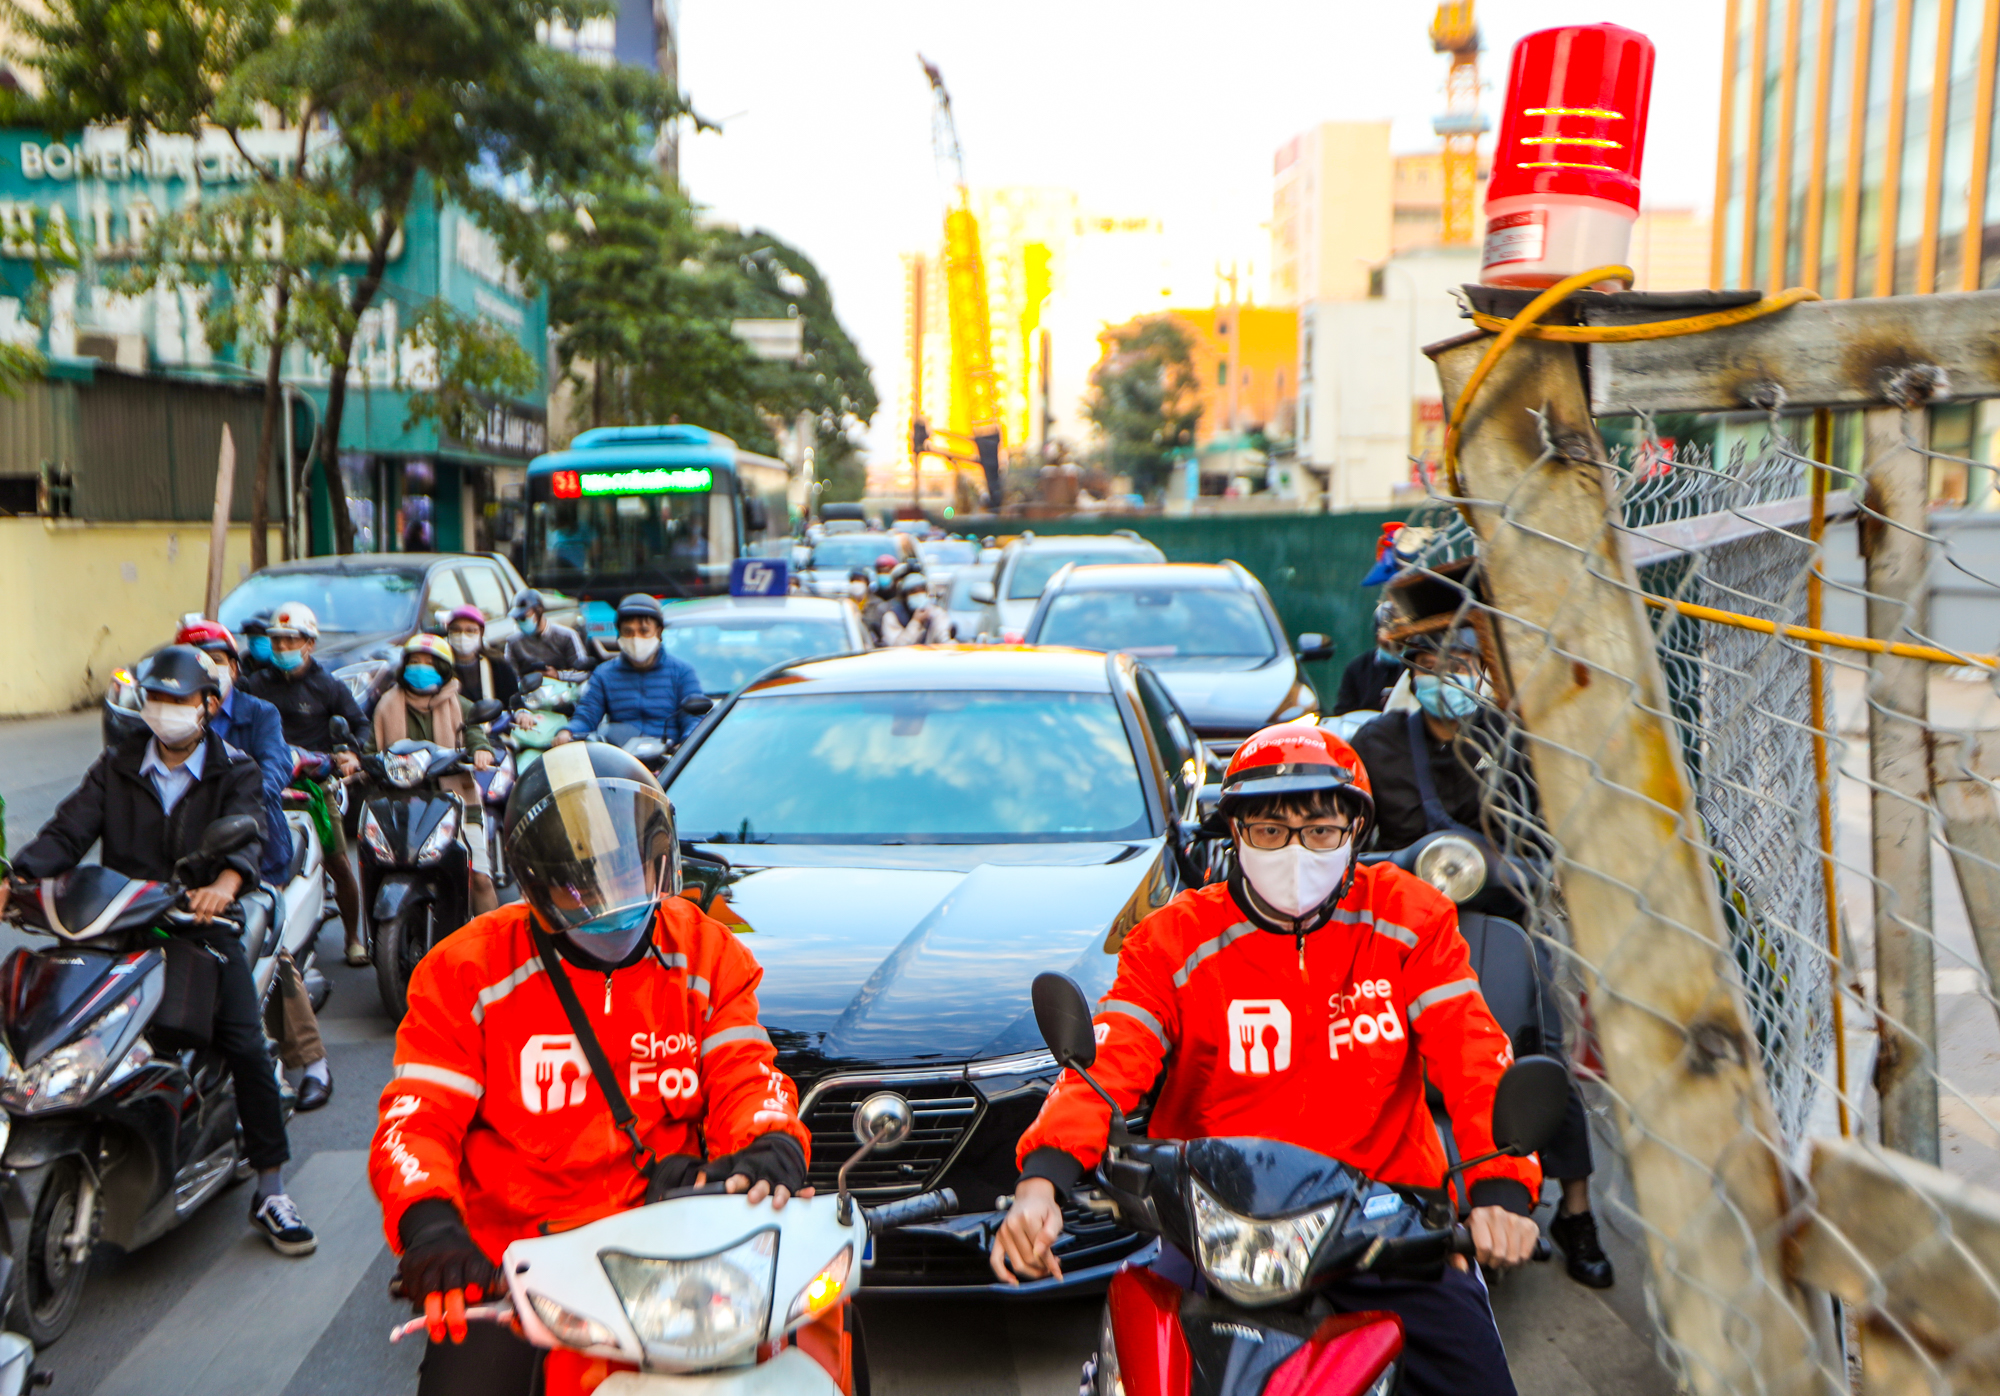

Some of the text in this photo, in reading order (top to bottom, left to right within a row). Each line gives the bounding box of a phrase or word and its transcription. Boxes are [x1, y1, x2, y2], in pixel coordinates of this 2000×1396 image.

[743, 561, 773, 592] G7
[1259, 735, 1327, 750] ShopeeFood
[1211, 1321, 1265, 1345] HONDA
